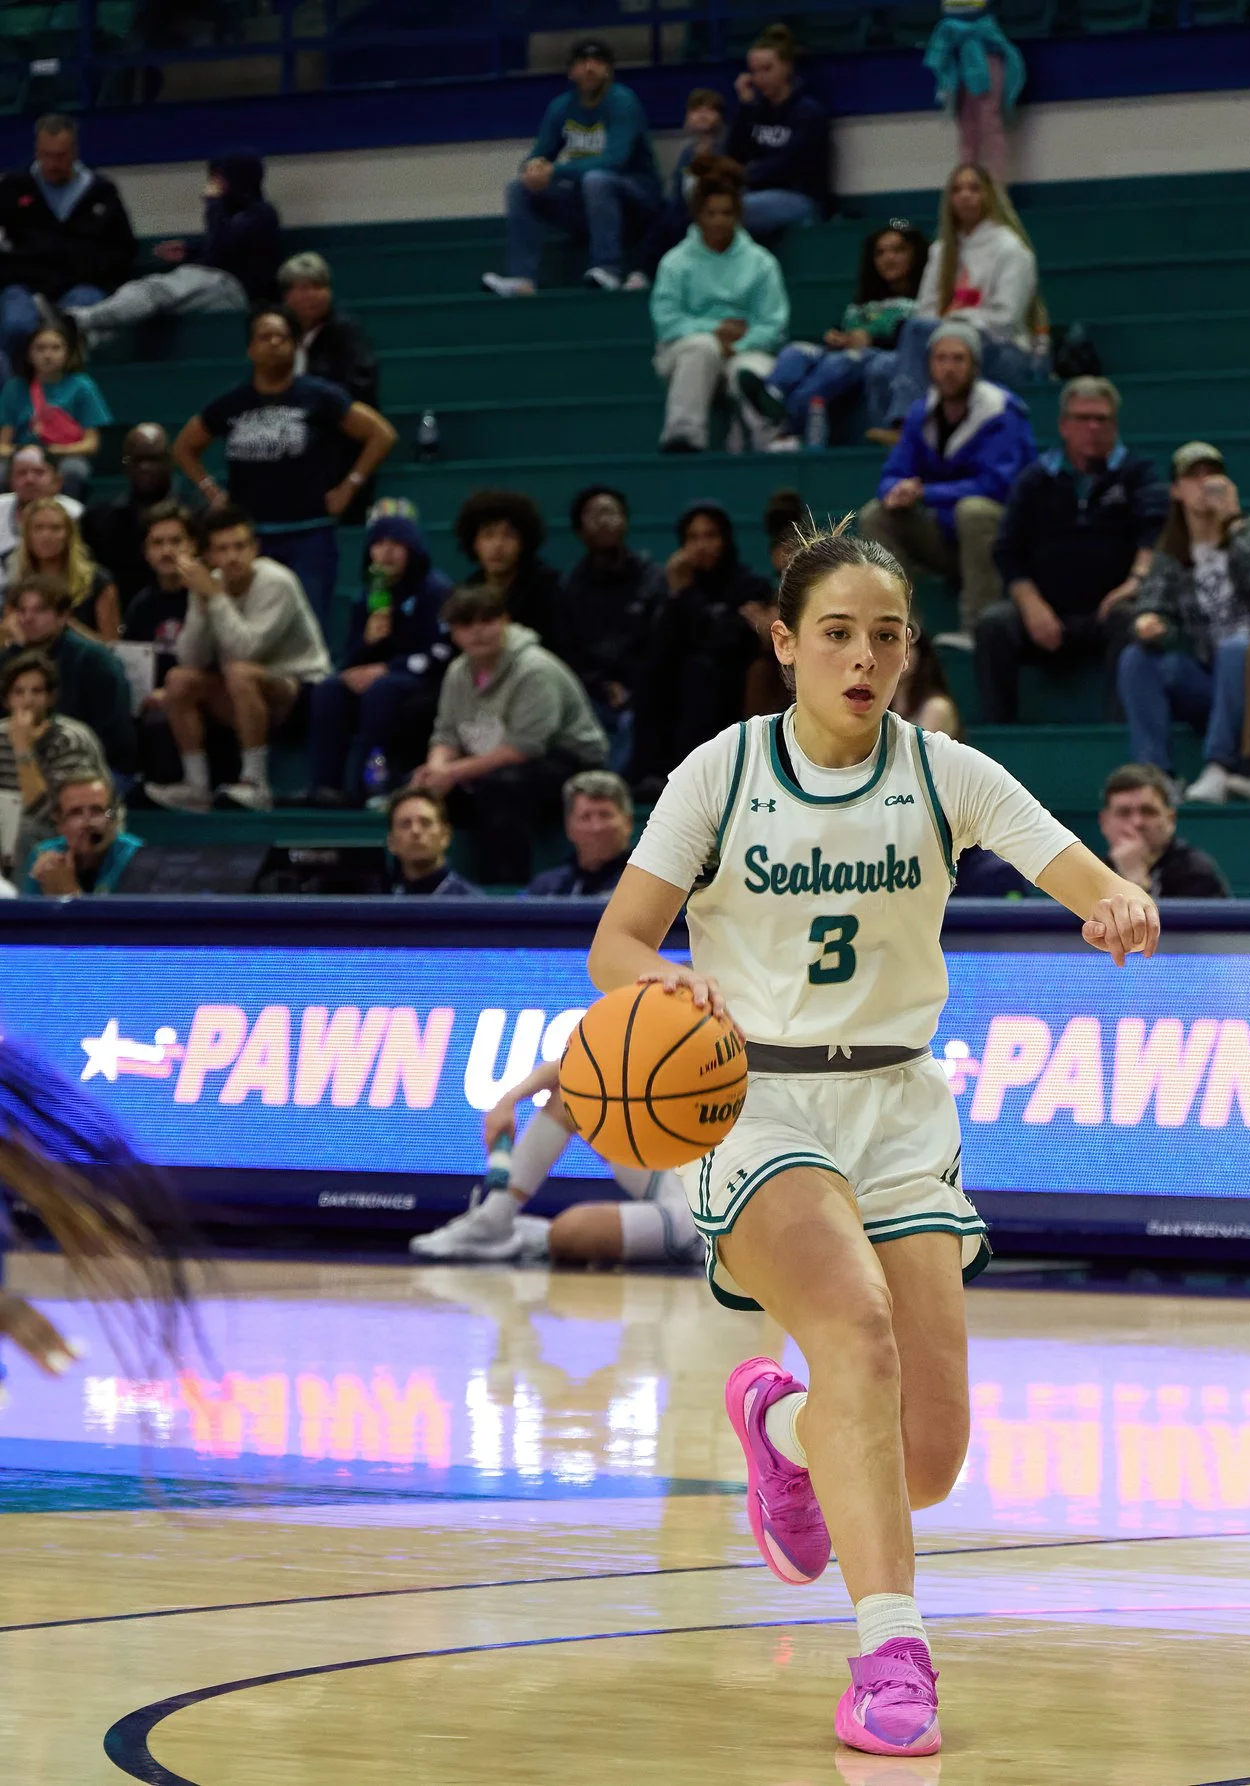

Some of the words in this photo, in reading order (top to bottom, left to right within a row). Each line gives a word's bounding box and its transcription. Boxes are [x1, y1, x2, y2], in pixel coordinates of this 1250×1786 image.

[885, 794, 915, 806] CAA
[744, 843, 922, 895] Seahawks
[808, 914, 860, 985] 3
[173, 1004, 456, 1110] PAWN
